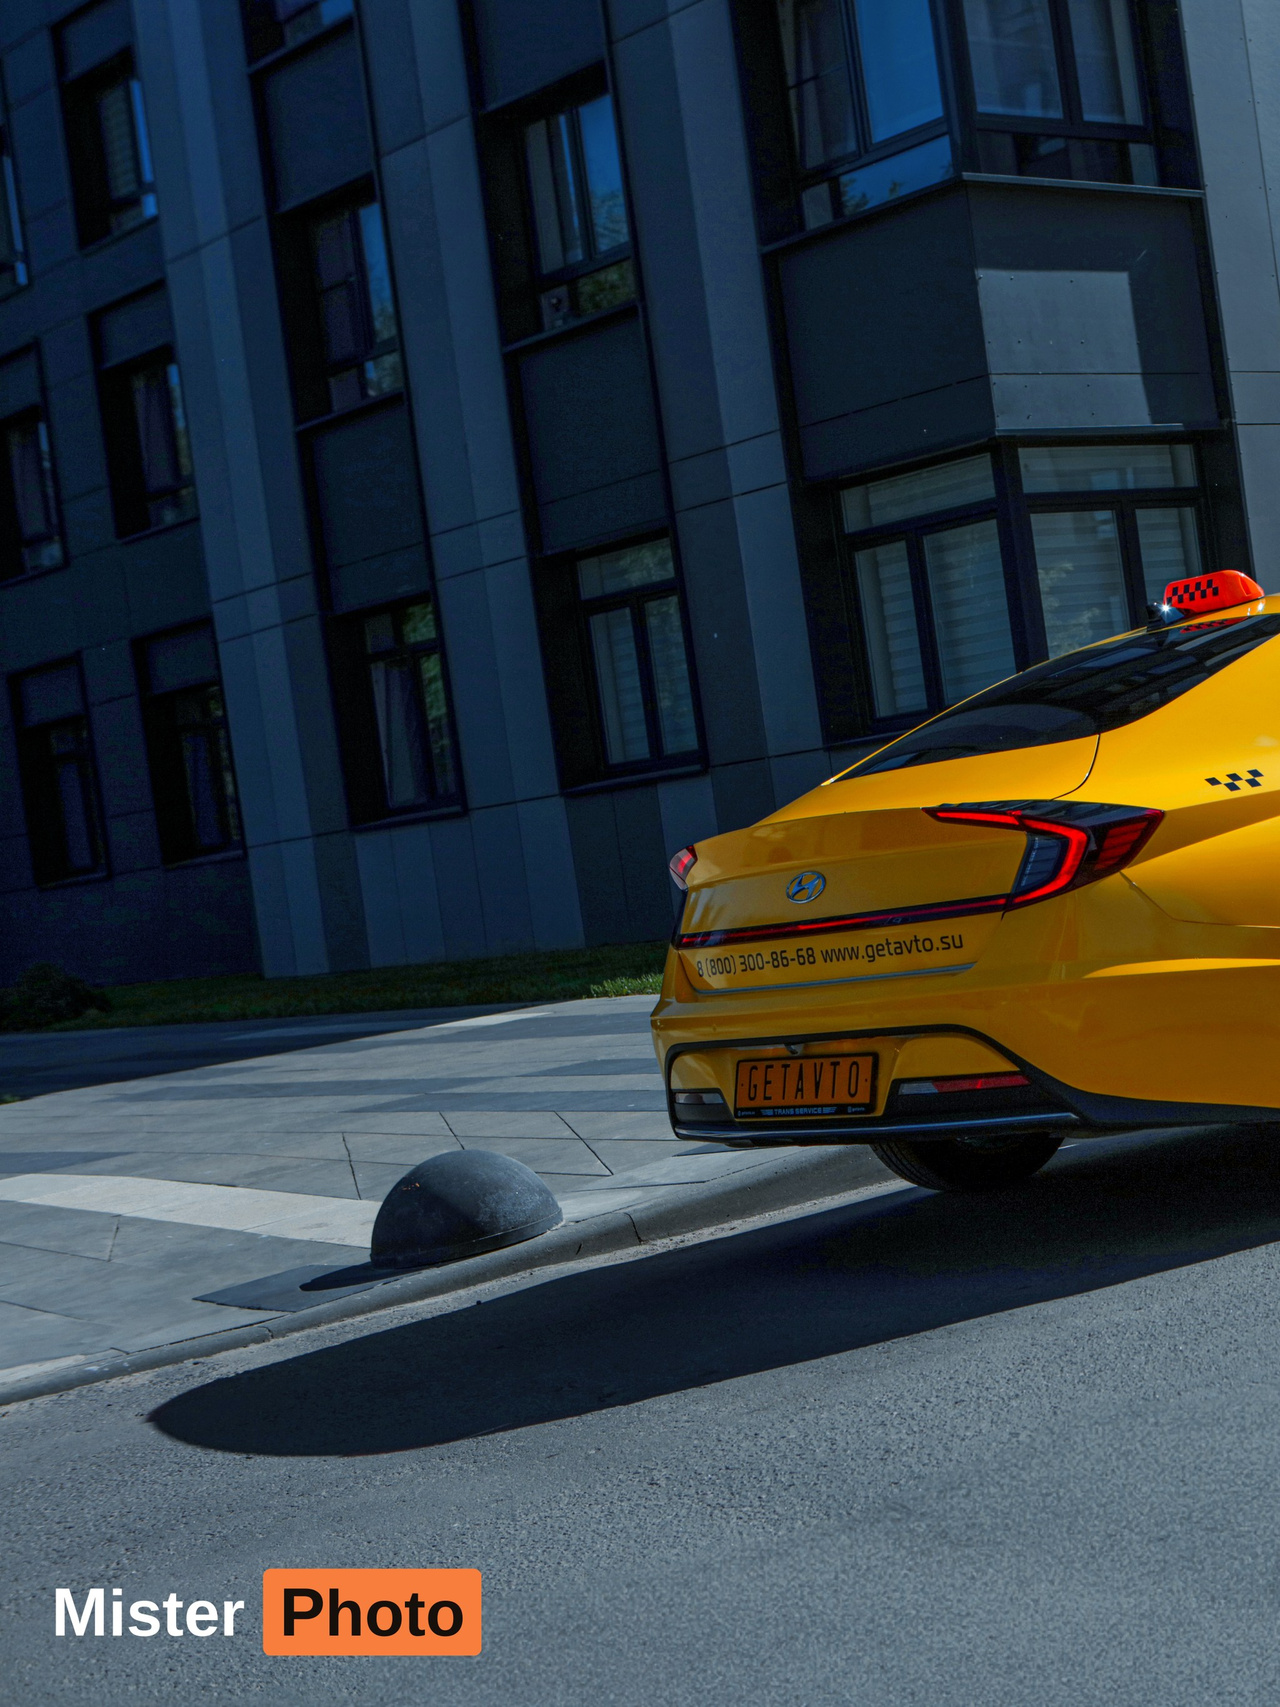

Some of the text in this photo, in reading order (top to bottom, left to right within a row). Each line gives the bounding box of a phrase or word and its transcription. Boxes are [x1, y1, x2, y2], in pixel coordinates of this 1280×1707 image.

[697, 934, 964, 977] 8 (800) 300-86-68 www.getavto.su
[748, 1061, 859, 1101] GETAVTO
